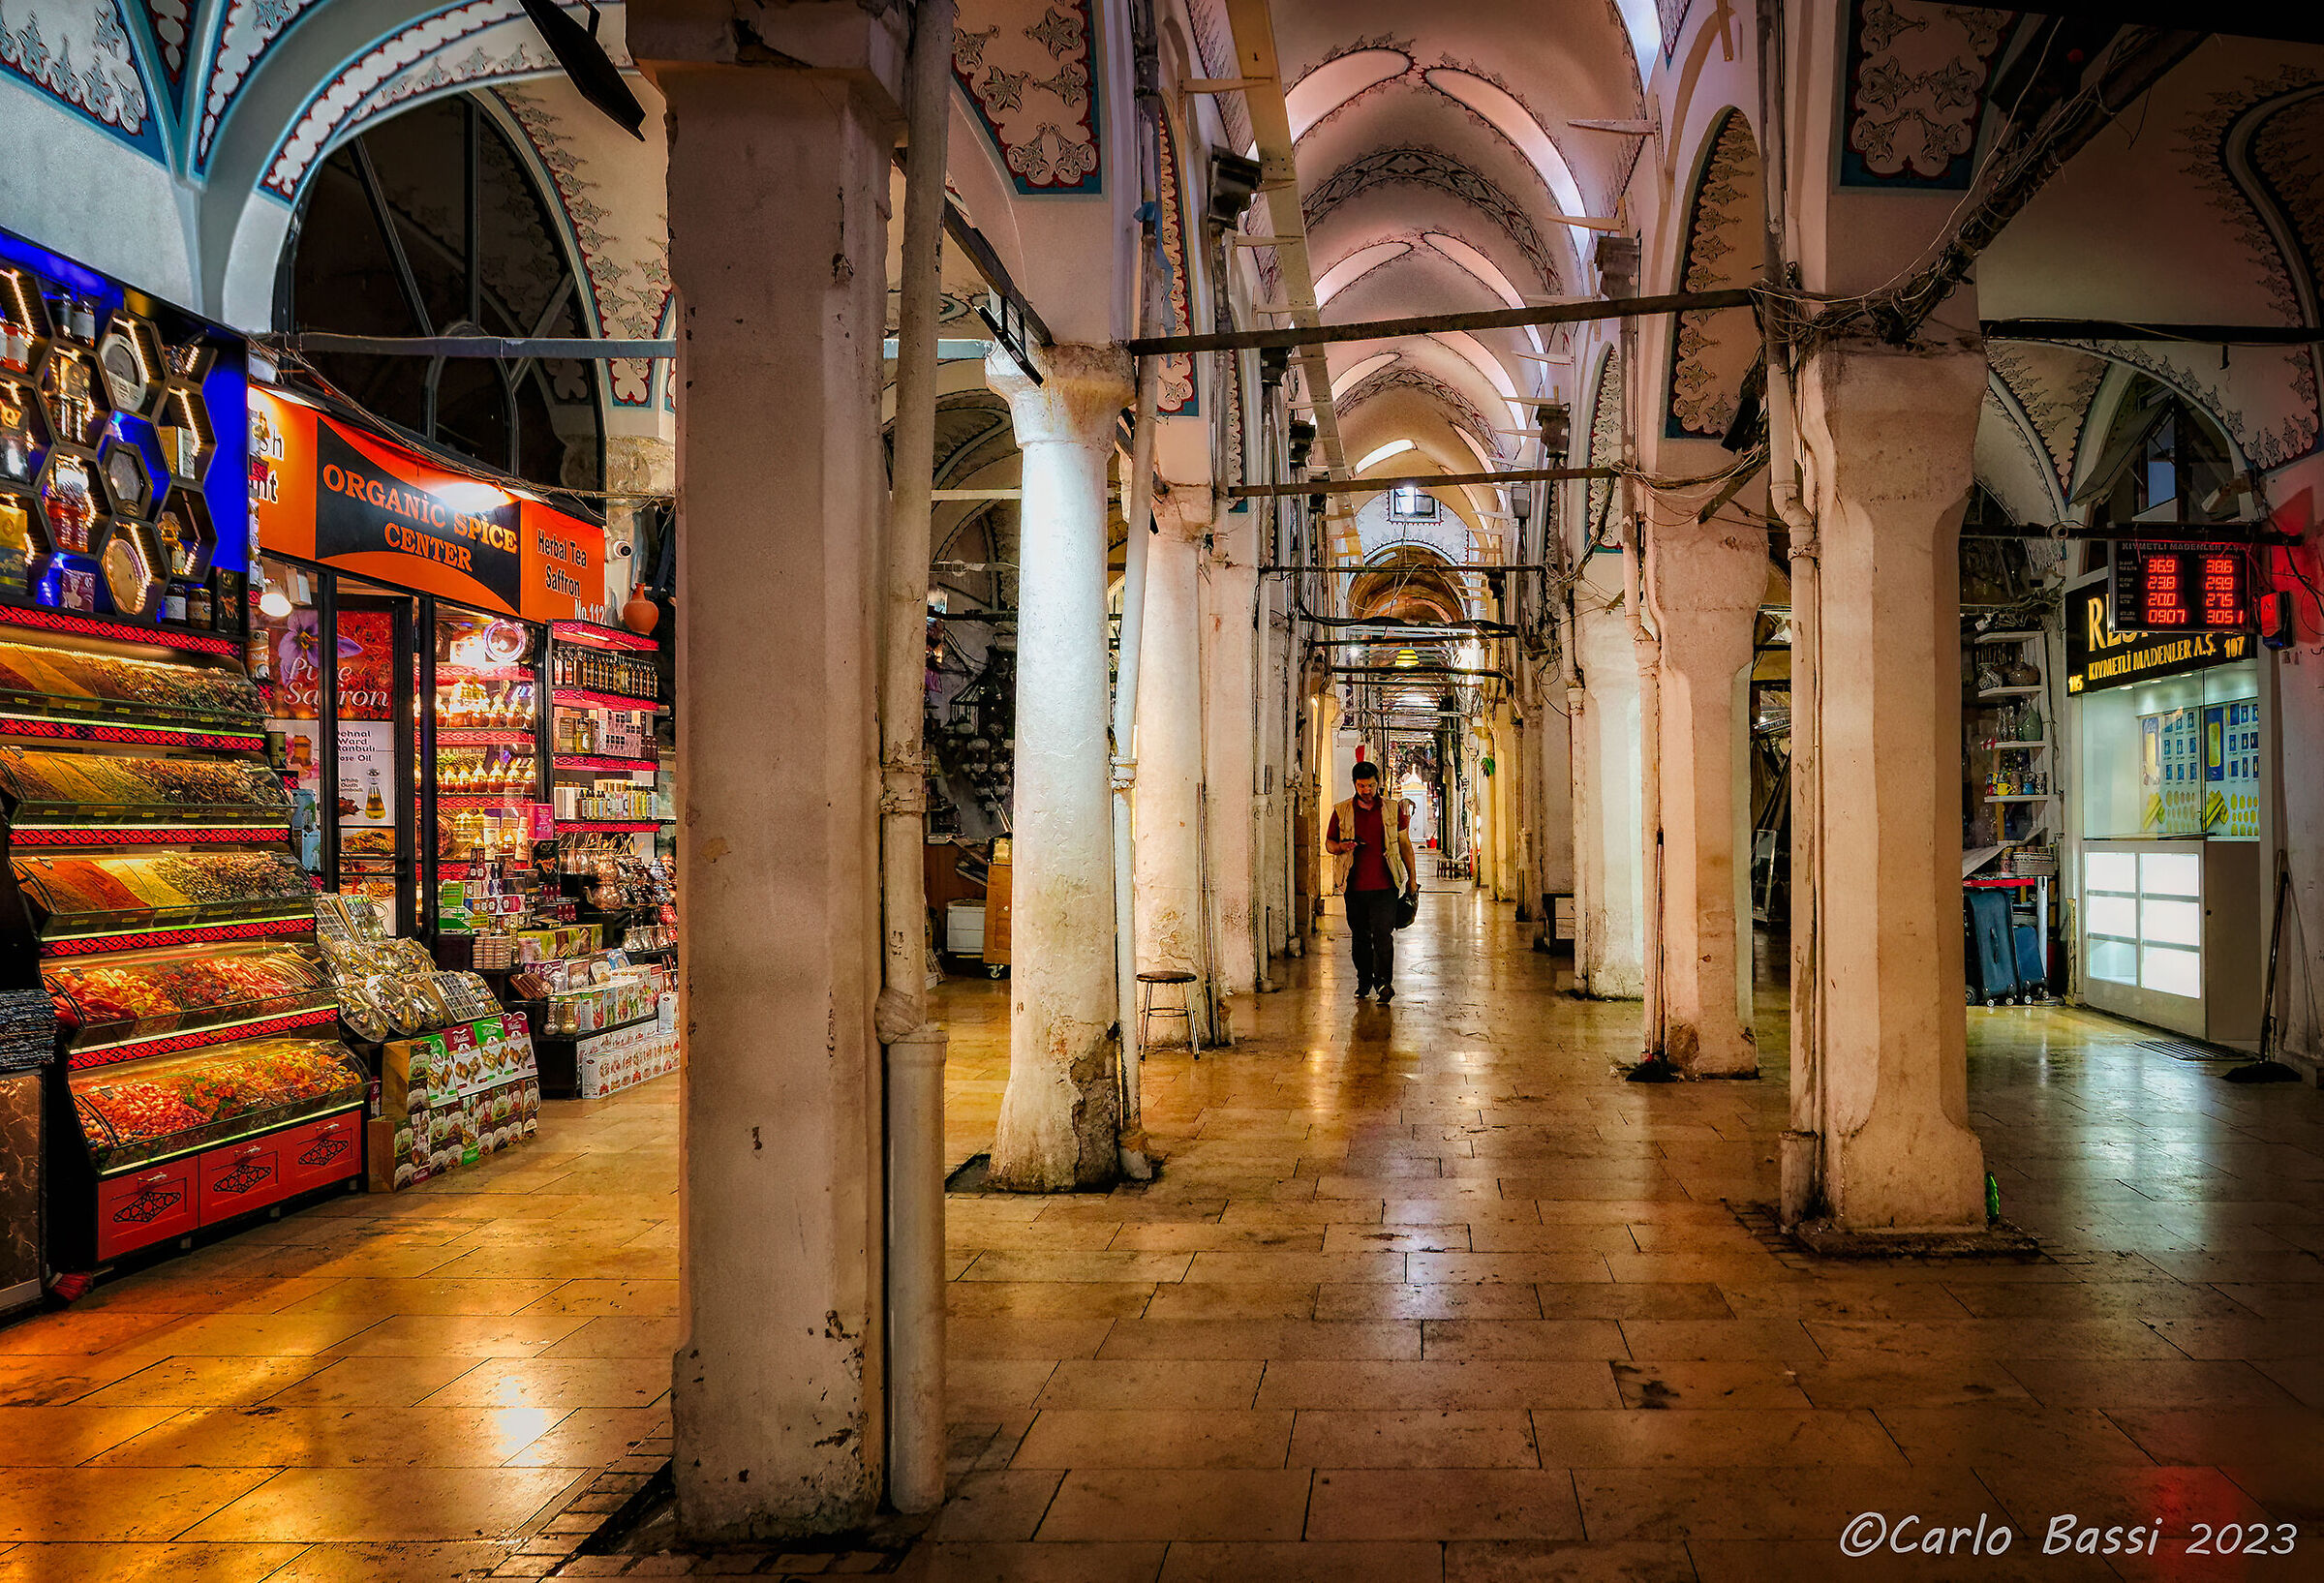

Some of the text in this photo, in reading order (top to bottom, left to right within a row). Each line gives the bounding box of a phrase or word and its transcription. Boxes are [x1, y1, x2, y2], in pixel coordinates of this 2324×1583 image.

[384, 522, 474, 572] CENTER
[537, 529, 587, 567] Herbal Tea
[545, 564, 580, 597] Saffron
[2088, 651, 2131, 681] KIYMETLİ
[2132, 639, 2192, 671] MADENLER
[2223, 635, 2246, 658] 107
[284, 656, 352, 681] Pue
